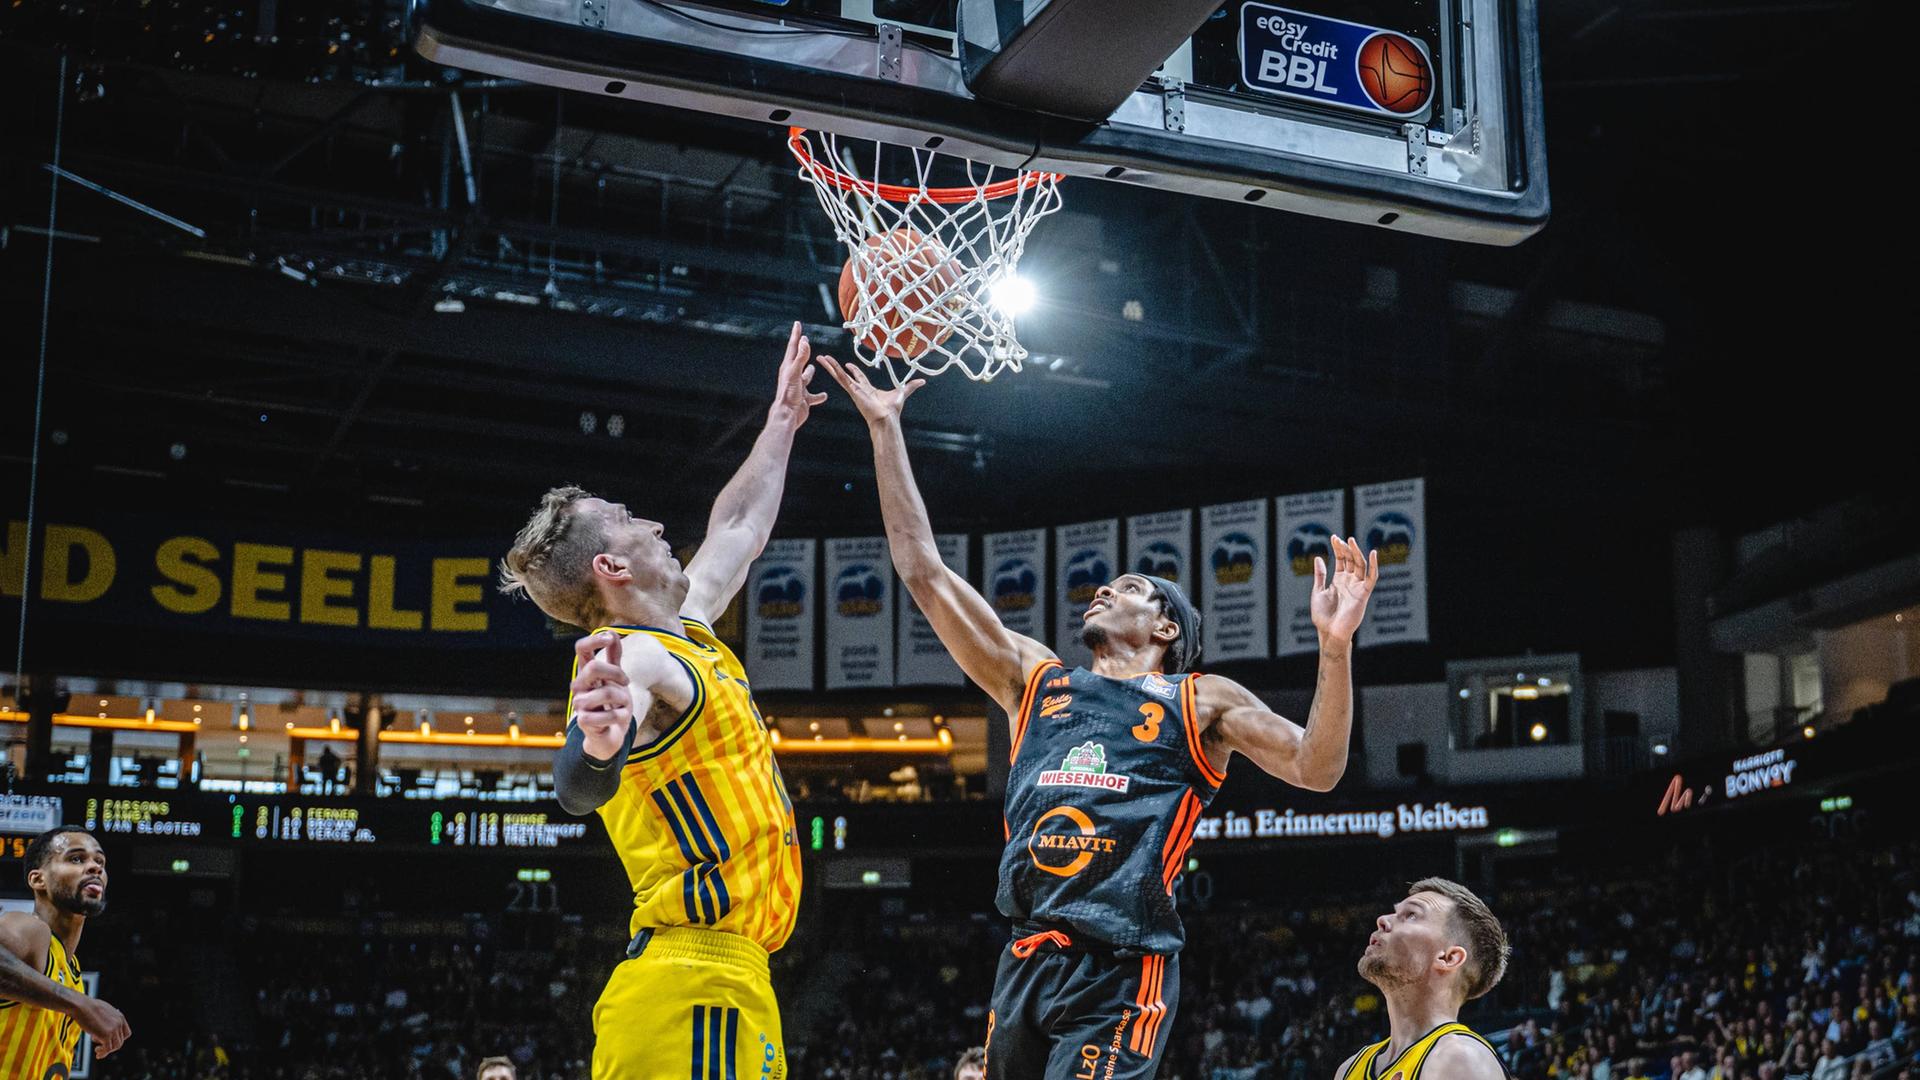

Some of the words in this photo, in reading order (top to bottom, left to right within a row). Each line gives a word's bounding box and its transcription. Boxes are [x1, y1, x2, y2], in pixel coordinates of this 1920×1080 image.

[1281, 35, 1339, 60] Credit
[1257, 49, 1338, 95] BBL
[151, 536, 491, 634] SEELE
[1132, 702, 1165, 743] 3
[1041, 772, 1127, 790] WIESENHOF
[1725, 761, 1795, 798] BONVOY
[103, 799, 170, 815] PARSONS
[1225, 810, 1252, 839] in
[1255, 808, 1397, 838] Erinnerung
[1397, 802, 1489, 832] bleiben
[102, 819, 133, 833] VAN
[137, 820, 201, 836] SLOOTEN
[1038, 835, 1116, 852] MIAVIT
[1076, 1044, 1101, 1080] LzO
